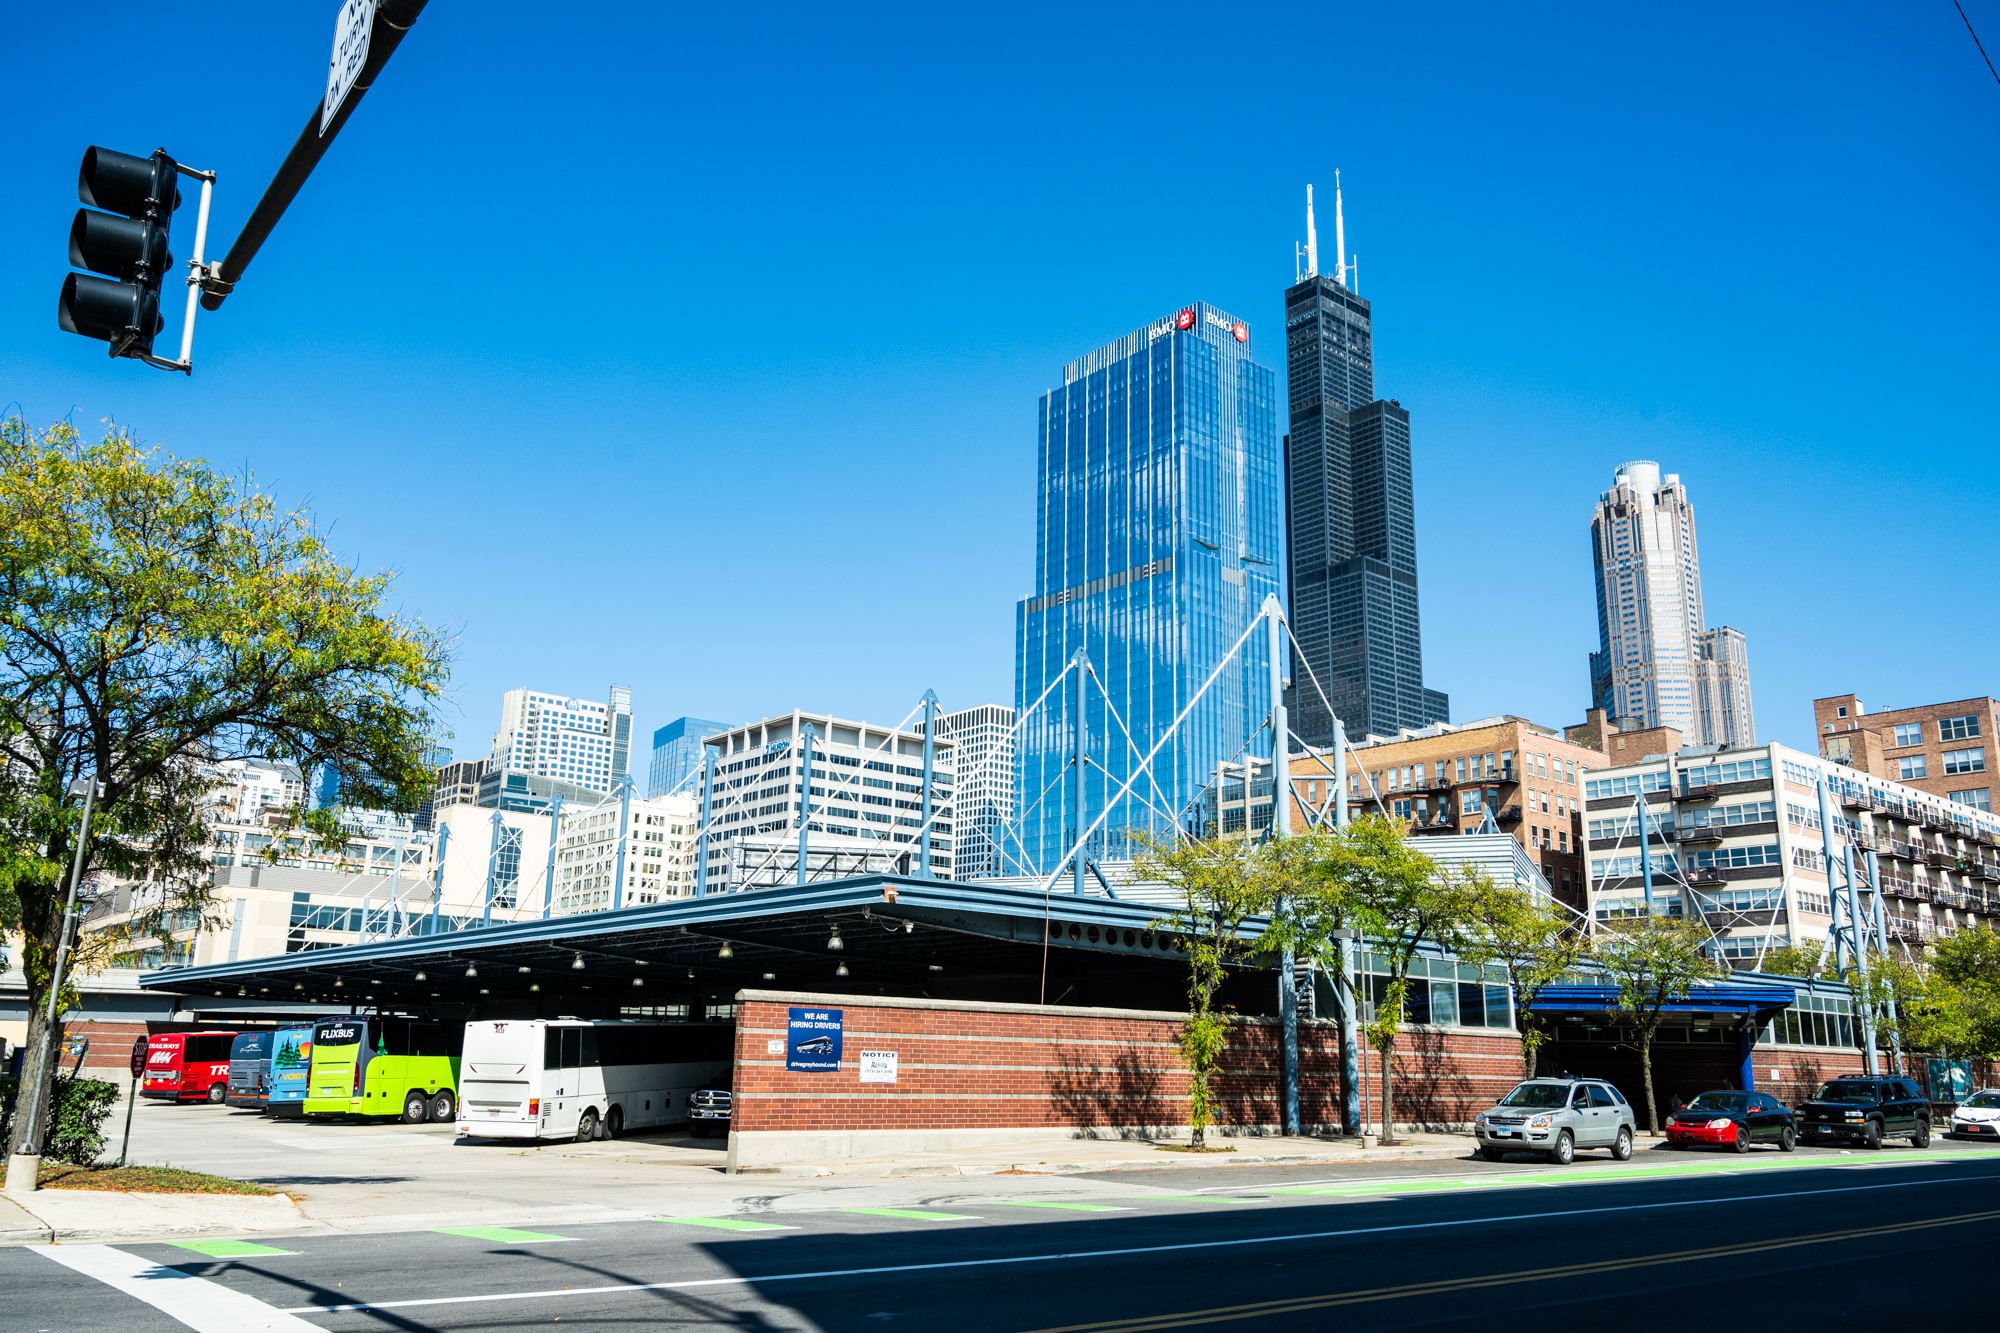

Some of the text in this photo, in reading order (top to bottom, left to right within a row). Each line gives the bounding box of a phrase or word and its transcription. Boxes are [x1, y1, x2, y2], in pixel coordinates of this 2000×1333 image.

[338, 5, 367, 65] TURN
[326, 34, 366, 111] ON RED
[1205, 312, 1232, 332] BMO
[1149, 320, 1176, 341] BMO
[770, 739, 791, 752] HURON
[790, 1021, 841, 1030] HIRING DRIVERS
[134, 1042, 148, 1055] STOP
[209, 1065, 230, 1076] TR
